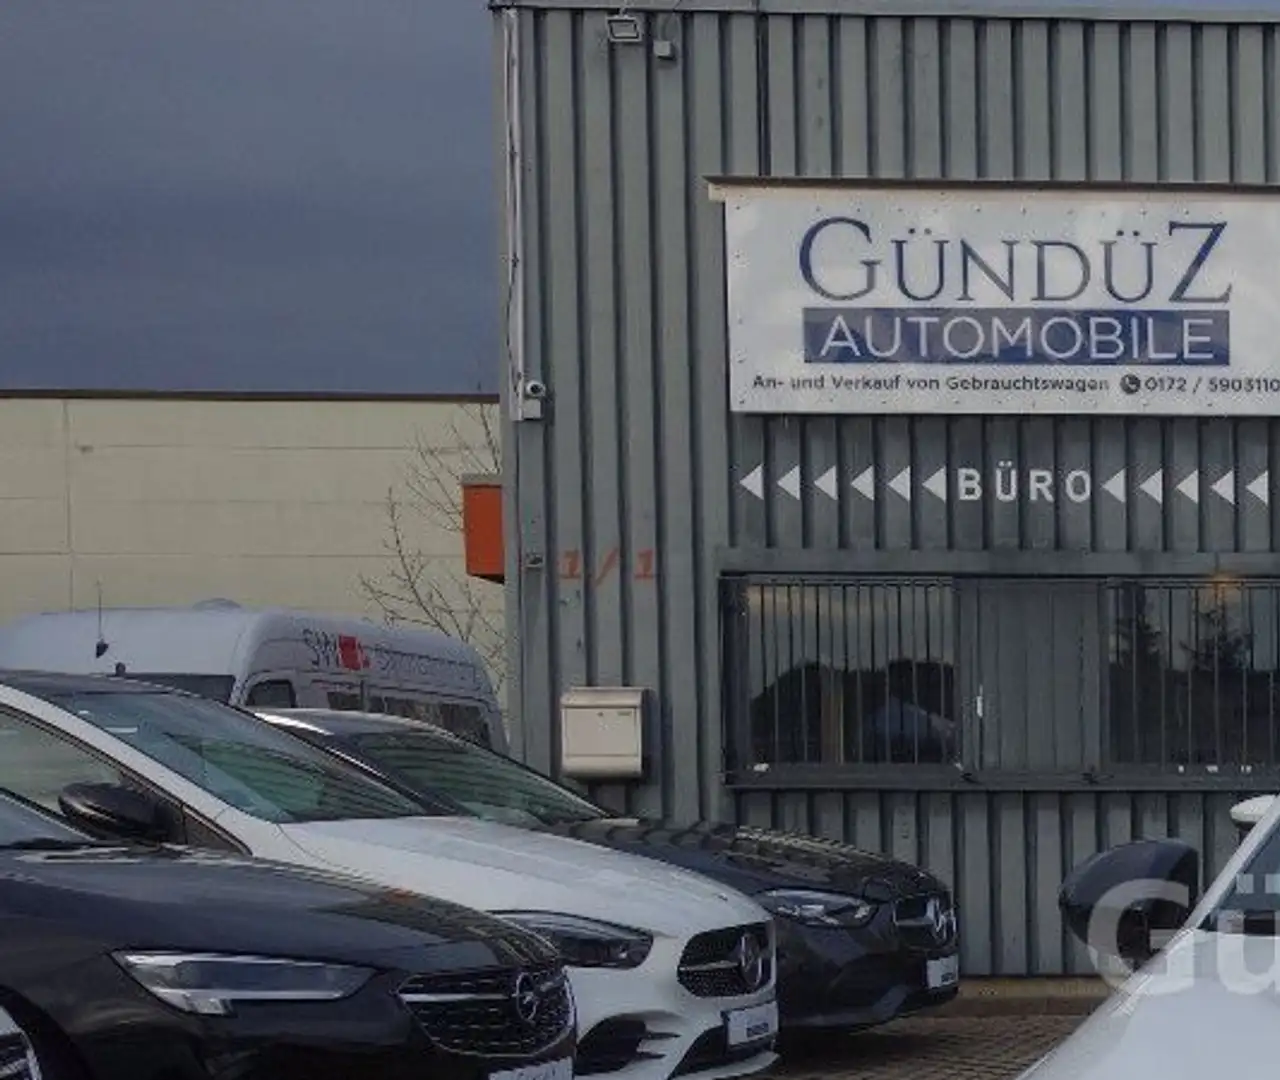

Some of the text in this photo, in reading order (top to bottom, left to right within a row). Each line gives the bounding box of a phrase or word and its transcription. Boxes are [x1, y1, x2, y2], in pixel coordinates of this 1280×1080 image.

[799, 215, 1235, 304] GÜNDÜZ
[819, 314, 1216, 361] AUTOMOBILE
[790, 376, 824, 390] und
[831, 375, 900, 390] Verkauf
[906, 378, 940, 390] von
[945, 374, 1110, 393] Gebrauchtswagen
[1144, 377, 1187, 393] 0172
[957, 461, 1093, 503] BÜRO
